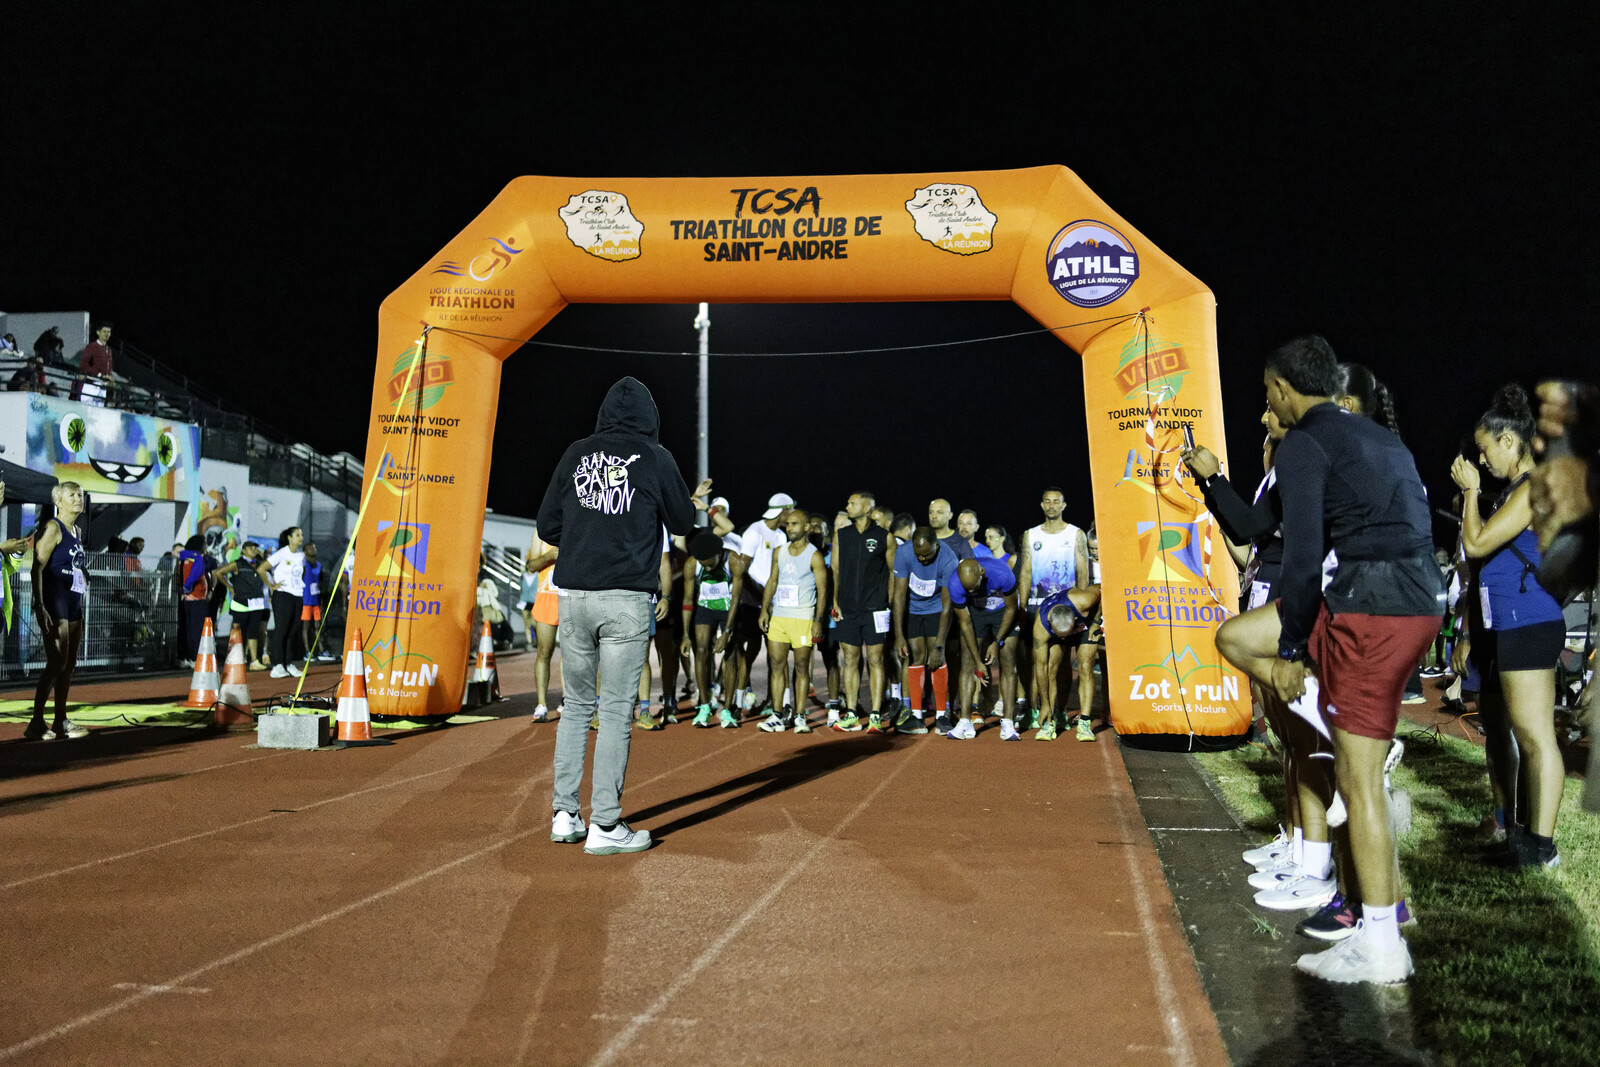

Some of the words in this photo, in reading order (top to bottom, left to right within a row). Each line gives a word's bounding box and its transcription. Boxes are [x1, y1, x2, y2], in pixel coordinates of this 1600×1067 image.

[926, 188, 958, 197] TCSA
[581, 195, 609, 204] TCSA
[730, 187, 823, 218] TCSA
[670, 218, 786, 240] TRIATHLON
[793, 217, 848, 237] CLUB
[854, 216, 882, 236] DE
[943, 241, 954, 249] LA
[954, 239, 990, 248] RÉUNION
[594, 247, 605, 255] LA
[605, 246, 639, 255] RÉUNION
[704, 239, 848, 262] SAINT-ANDRE
[1052, 256, 1135, 281] ATHLE
[1059, 280, 1077, 289] LIGUE
[1097, 276, 1128, 284] RÉUNION
[429, 287, 452, 295] LIGUE
[454, 286, 501, 296] RÉGIONALE
[429, 296, 515, 309] TRIATHLON
[470, 313, 502, 322] RÉUNION
[1171, 408, 1203, 418] VIDOT
[377, 414, 426, 424] TOURNANT
[428, 416, 461, 427] VIDOT
[382, 426, 409, 435] SAINT
[411, 427, 449, 438] ANDRE
[387, 471, 415, 481] SAINT
[419, 473, 455, 485] ANDRÉ
[1136, 468, 1170, 478] SAINT
[357, 577, 444, 591] DÉPARTEMENT
[355, 589, 441, 615] Réunion
[1158, 595, 1170, 603] DE
[1125, 598, 1226, 622] Réunion
[378, 687, 385, 696] &
[386, 688, 418, 698] Nature
[1128, 674, 1171, 700] Zot
[1151, 702, 1183, 713] Sports
[1185, 703, 1193, 712] &
[1194, 703, 1227, 714] Nature
